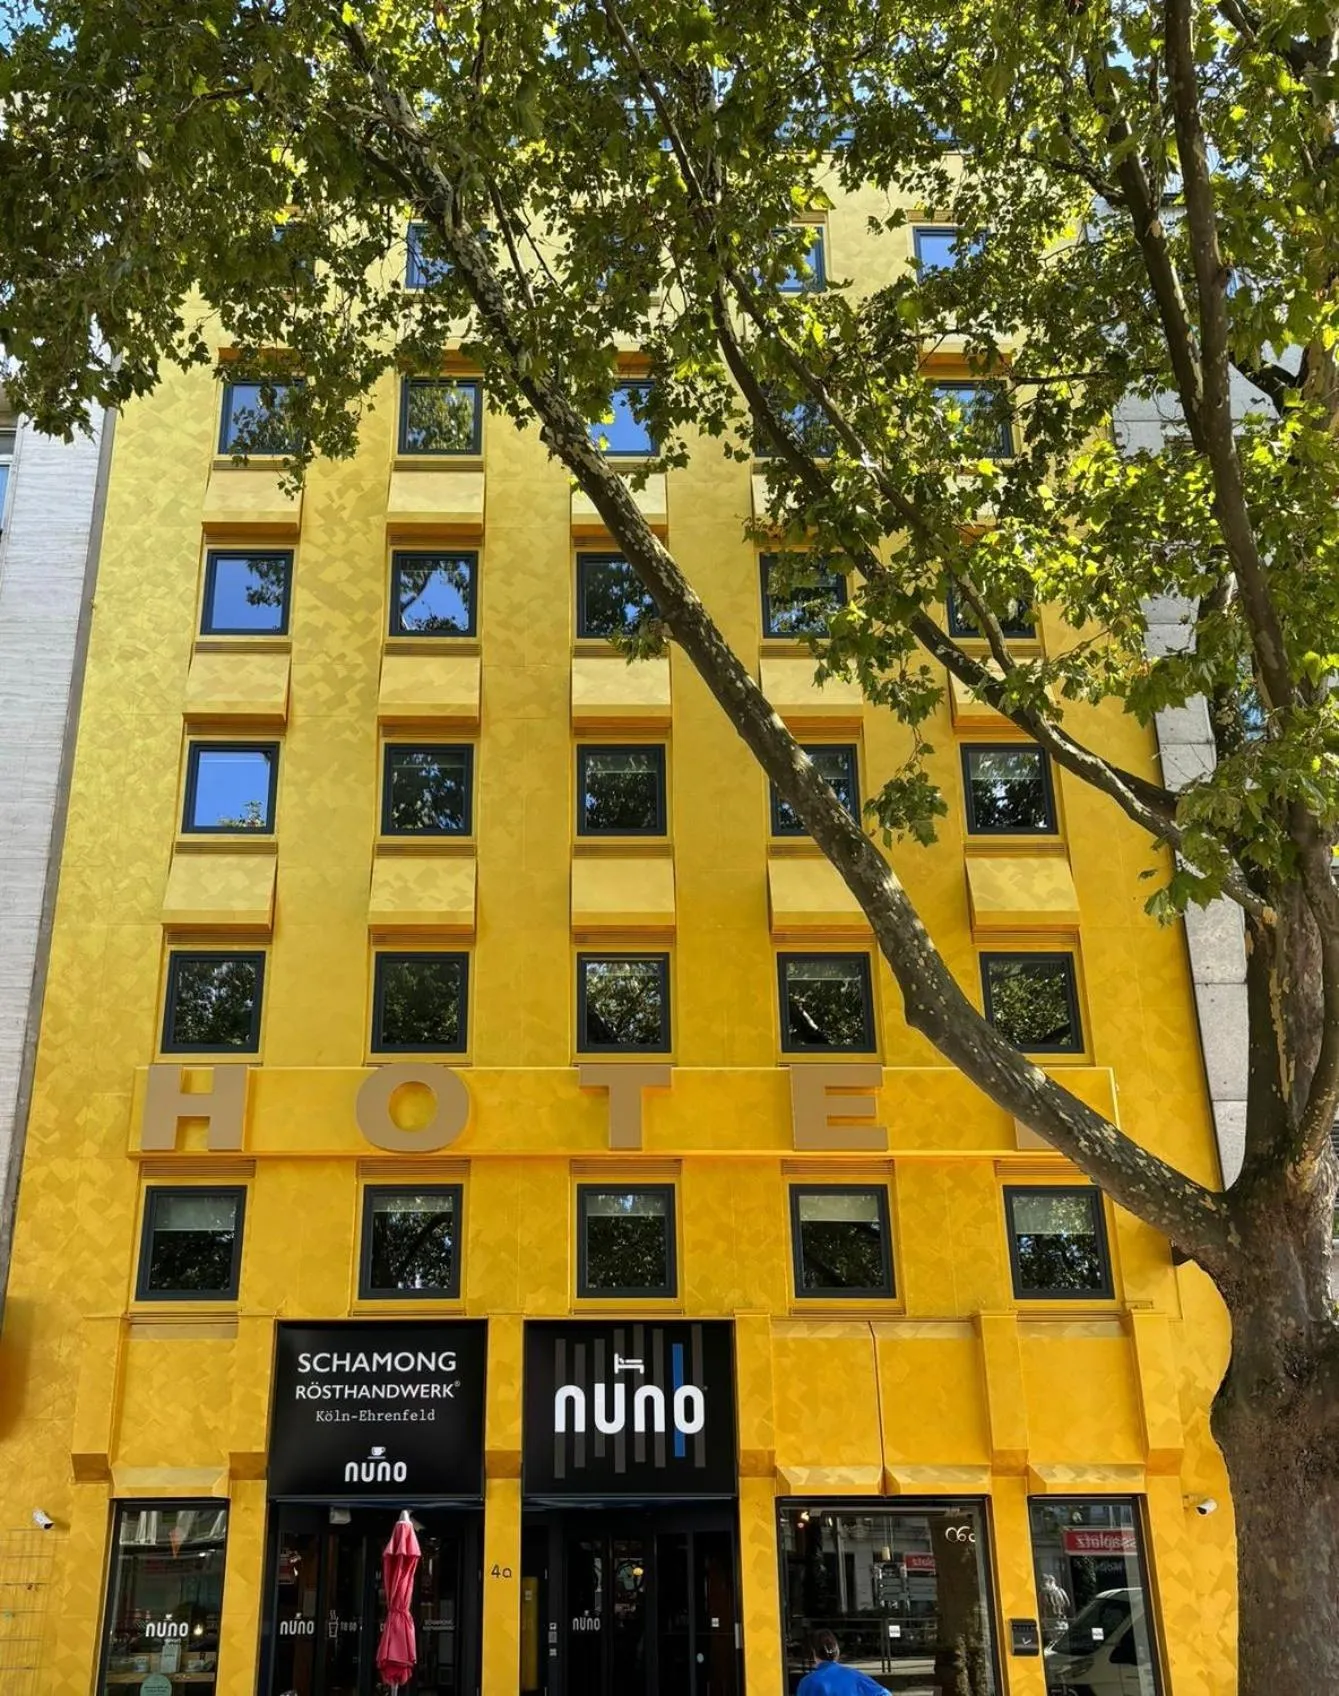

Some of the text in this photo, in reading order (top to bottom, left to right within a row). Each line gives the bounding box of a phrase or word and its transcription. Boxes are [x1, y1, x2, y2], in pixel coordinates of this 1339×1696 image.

[297, 1352, 457, 1373] SCHAMONG
[315, 1409, 436, 1422] Köln-Ehrenfeld
[554, 1383, 705, 1435] nuno
[344, 1461, 408, 1483] nuno
[491, 1564, 512, 1578] 4a
[145, 1622, 189, 1637] nuno
[280, 1620, 315, 1635] nuno
